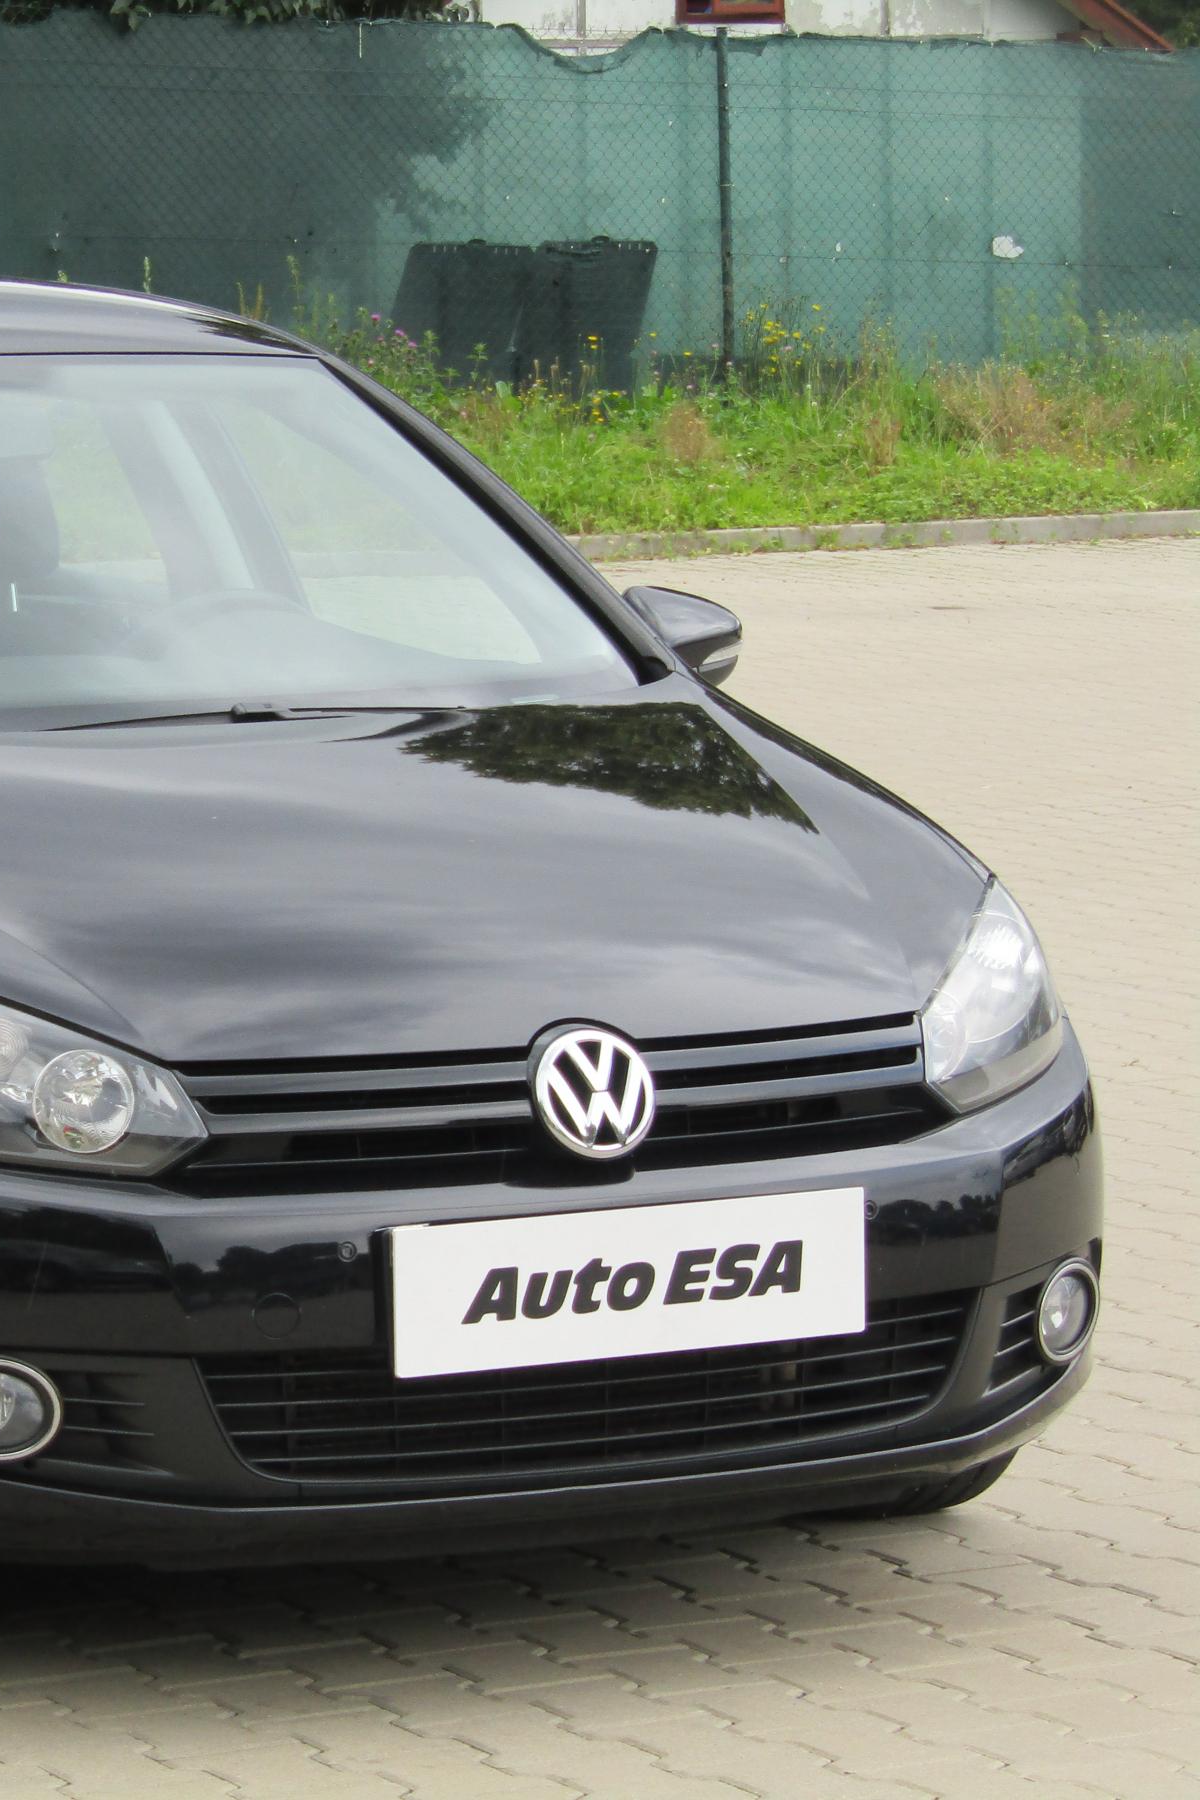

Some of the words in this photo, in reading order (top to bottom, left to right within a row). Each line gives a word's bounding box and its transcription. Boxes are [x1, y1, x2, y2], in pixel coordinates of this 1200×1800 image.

[537, 1030, 654, 1158] VW
[461, 1258, 655, 1324] Auto
[663, 1240, 803, 1305] ESA
